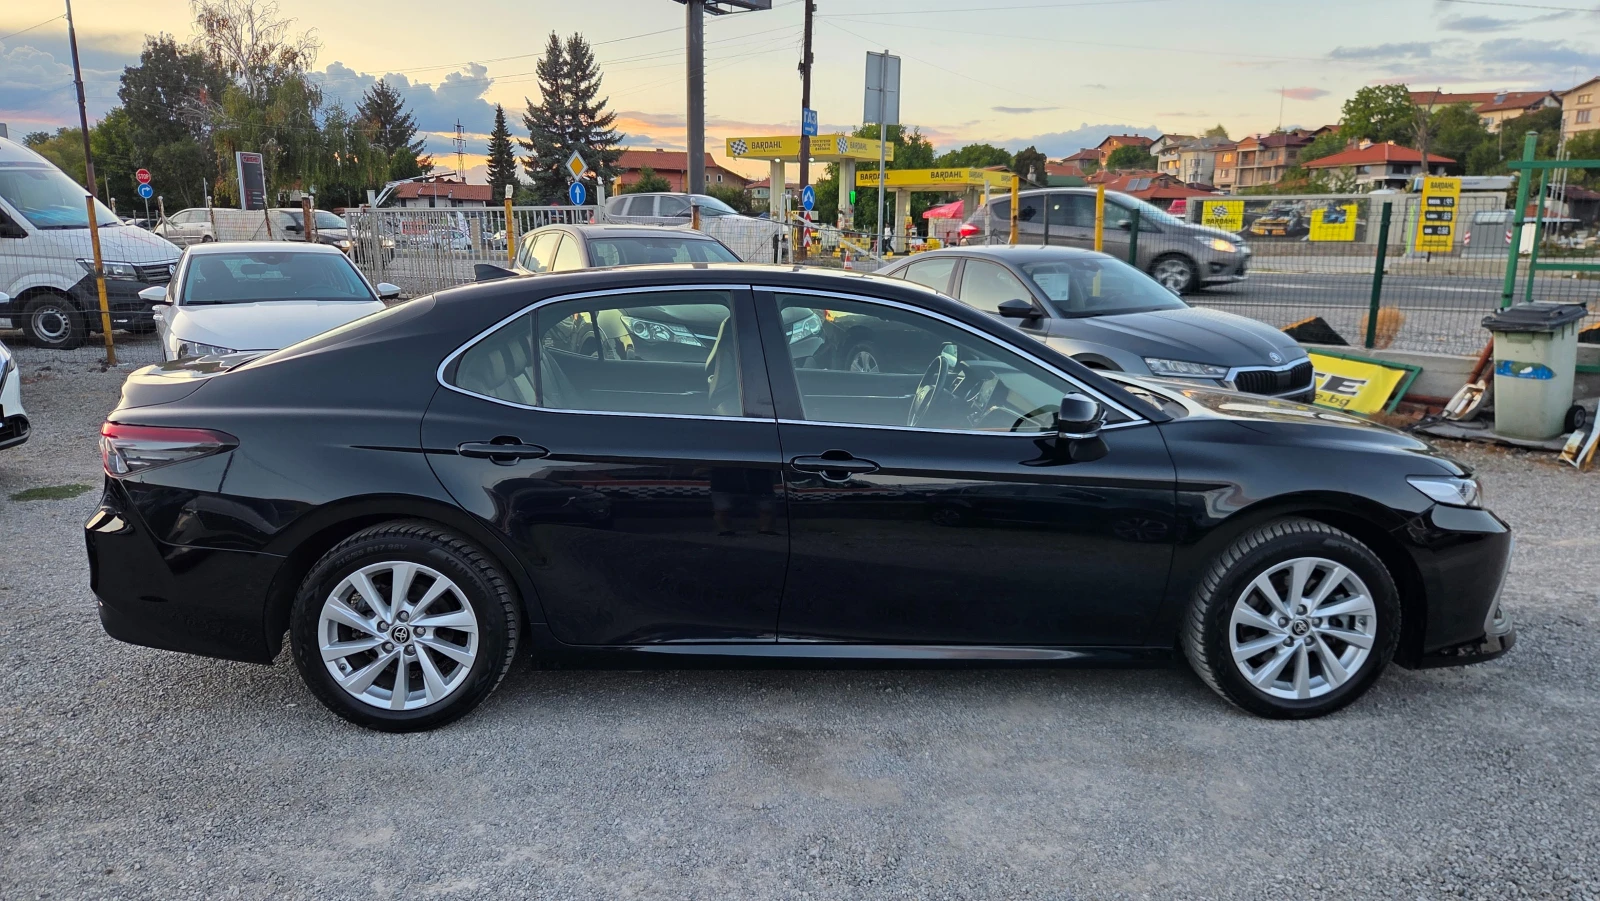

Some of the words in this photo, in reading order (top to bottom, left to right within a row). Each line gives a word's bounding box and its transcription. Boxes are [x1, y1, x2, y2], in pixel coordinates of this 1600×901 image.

[803, 110, 817, 125] ГАЗ
[751, 141, 783, 152] BARDAHL
[930, 171, 963, 182] BARDAHL
[1430, 181, 1455, 192] BARDAHL
[1205, 218, 1238, 229] BARDAHL
[443, 556, 488, 600] KUMHO
